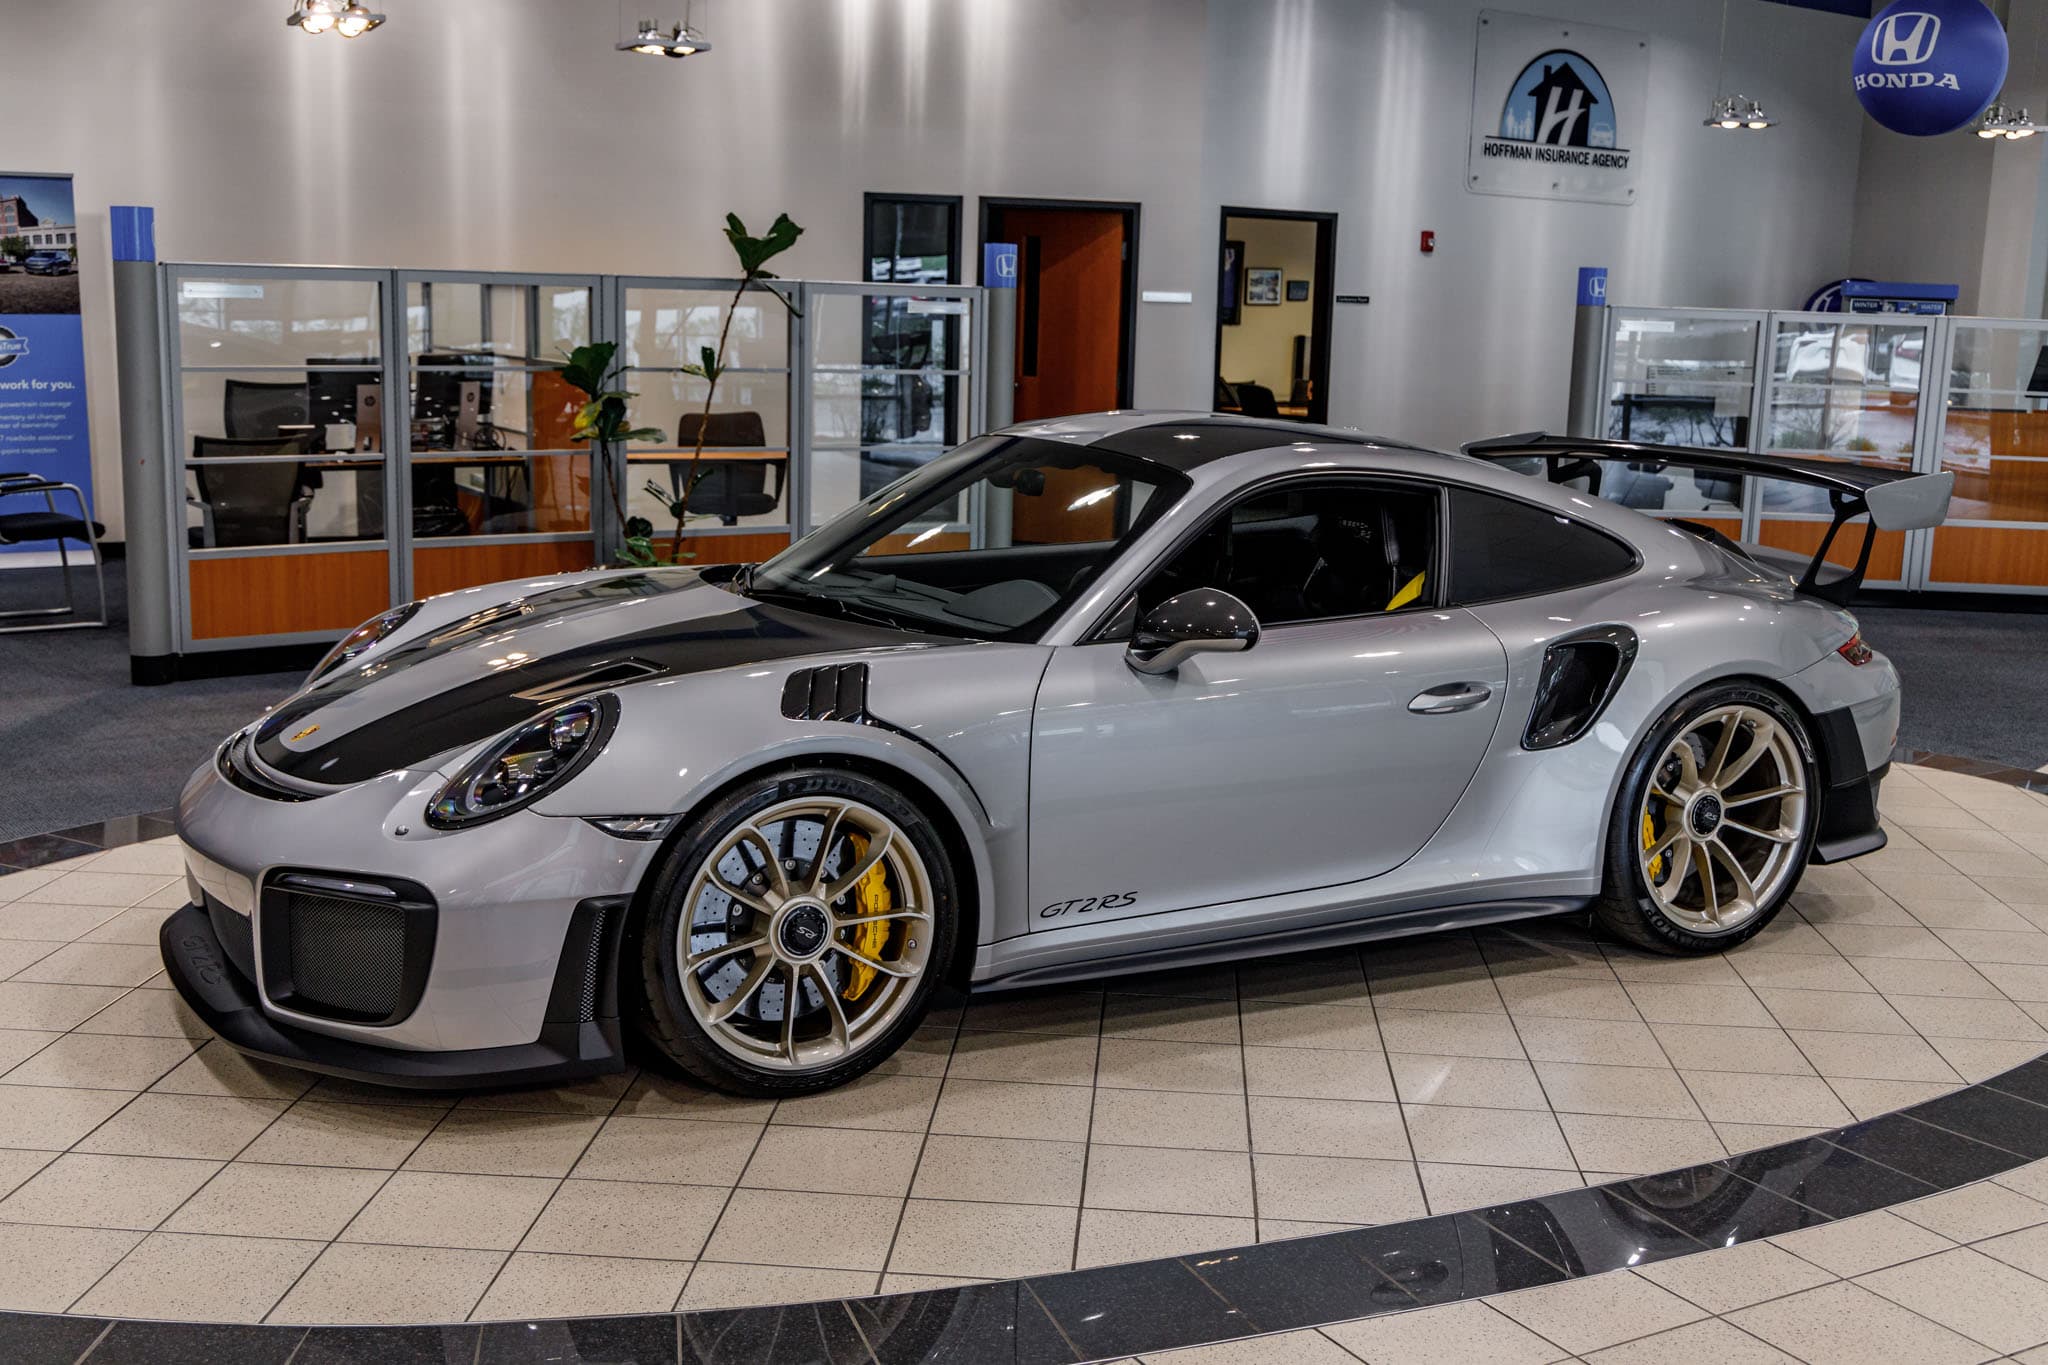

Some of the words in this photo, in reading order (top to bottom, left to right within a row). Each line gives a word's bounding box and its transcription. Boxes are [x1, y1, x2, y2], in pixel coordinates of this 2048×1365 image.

[1854, 72, 1960, 91] HONDA
[1483, 142, 1532, 159] HOFFMAN
[1535, 147, 1590, 166] INSURANCE
[1591, 153, 1630, 169] AGENCY
[0, 380, 30, 390] work
[31, 379, 48, 390] for
[50, 381, 76, 392] you.
